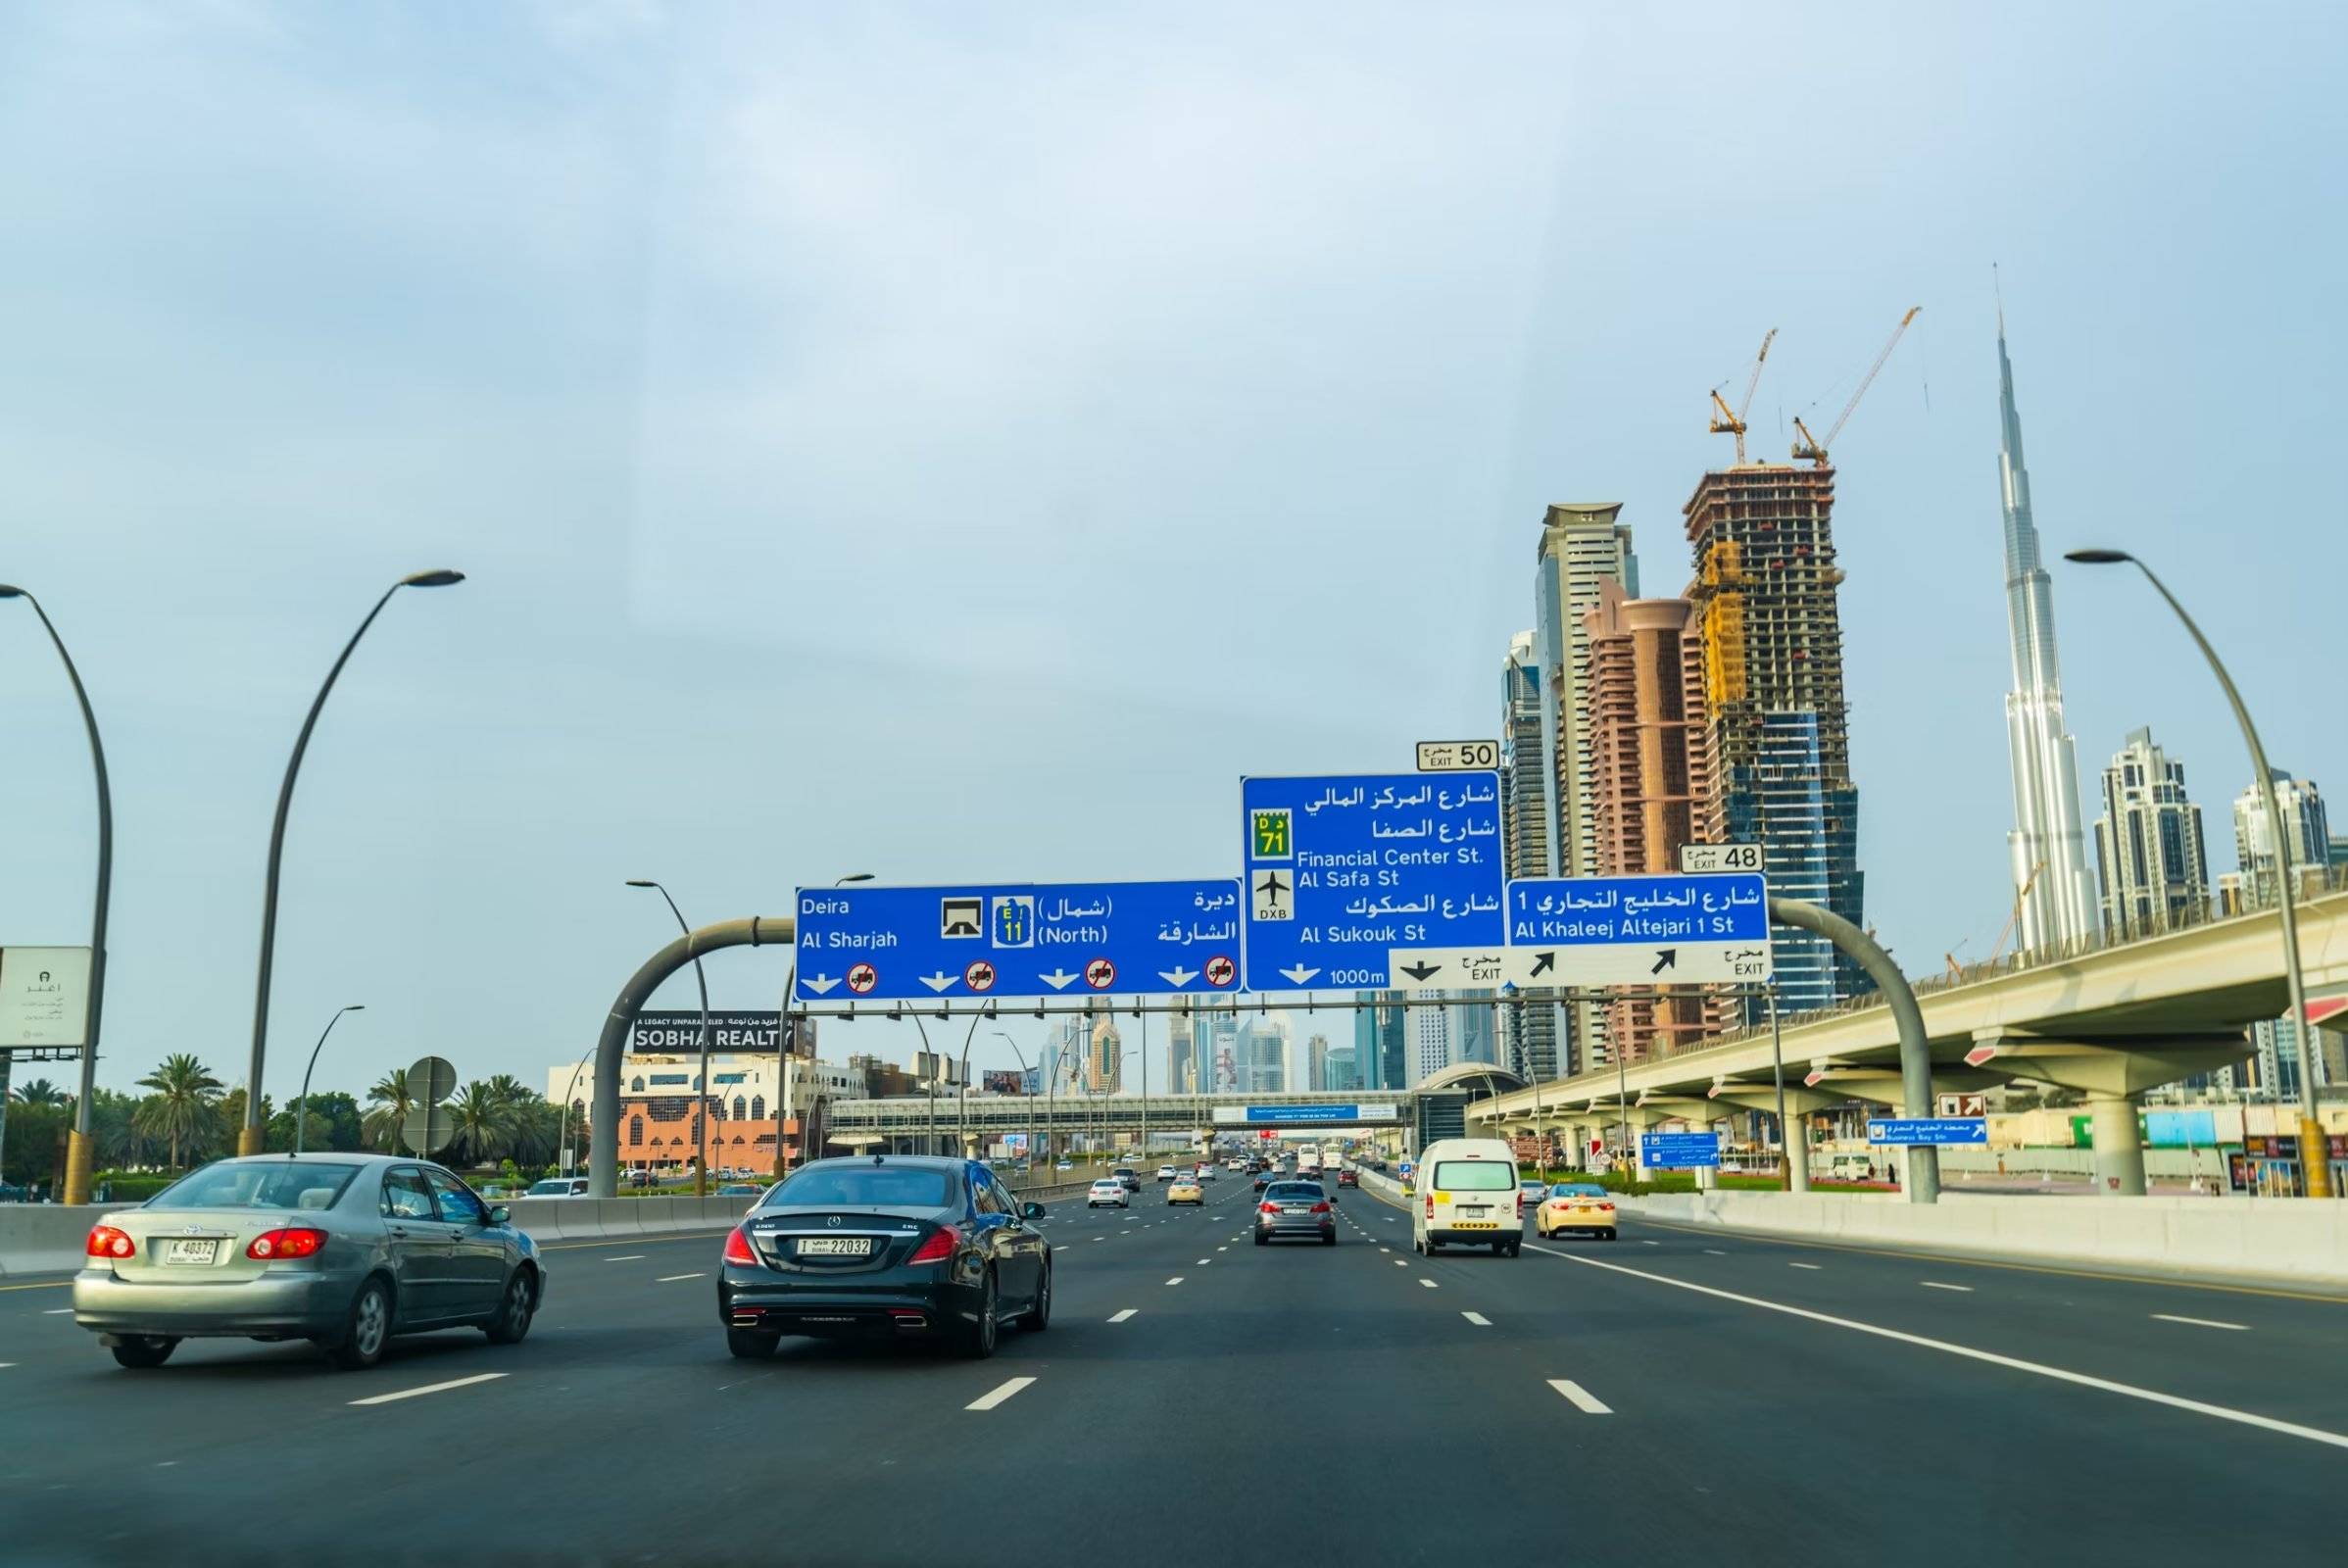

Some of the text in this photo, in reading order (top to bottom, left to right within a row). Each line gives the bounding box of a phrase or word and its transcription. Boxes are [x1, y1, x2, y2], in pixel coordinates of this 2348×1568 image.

[1423, 746, 1453, 758] مخرج
[1460, 744, 1492, 765] 50
[1430, 757, 1453, 767] EXIT
[1304, 785, 1495, 816] شارع المركز المالي
[1258, 816, 1269, 830] D
[1372, 817, 1496, 843] شارع الصفا
[1260, 831, 1284, 853] 71
[1297, 848, 1484, 867] Financial Center St.
[1687, 849, 1717, 860] مخرج
[1693, 859, 1717, 869] EXIT
[1724, 847, 1757, 868] 48
[1298, 869, 1399, 888] Al Safa St
[802, 899, 850, 914] Deira
[1038, 895, 1113, 921] (شمال)
[1194, 890, 1236, 911] ديرة
[1345, 892, 1500, 919] شارع الصكوك
[1537, 890, 1618, 916] التجاري
[1623, 888, 1696, 915] الخليج
[1702, 886, 1761, 913] شارع
[1003, 907, 1012, 919] E
[1259, 909, 1287, 920] DXB
[1004, 921, 1021, 942] 11
[1038, 926, 1107, 945] (North)
[1157, 921, 1236, 946] الشارقة
[1300, 924, 1426, 943] Al Sukouk St
[1515, 916, 1735, 939] Al Khaleej Altejari 1 St
[802, 931, 898, 950] Al Sharjah
[1461, 954, 1501, 968] مخرج
[1724, 947, 1764, 961] مخرج
[1471, 968, 1501, 980] EXIT
[1735, 962, 1764, 975] EXIT
[635, 1030, 793, 1047] SOBHA REALTY
[830, 1240, 870, 1253] 22032
